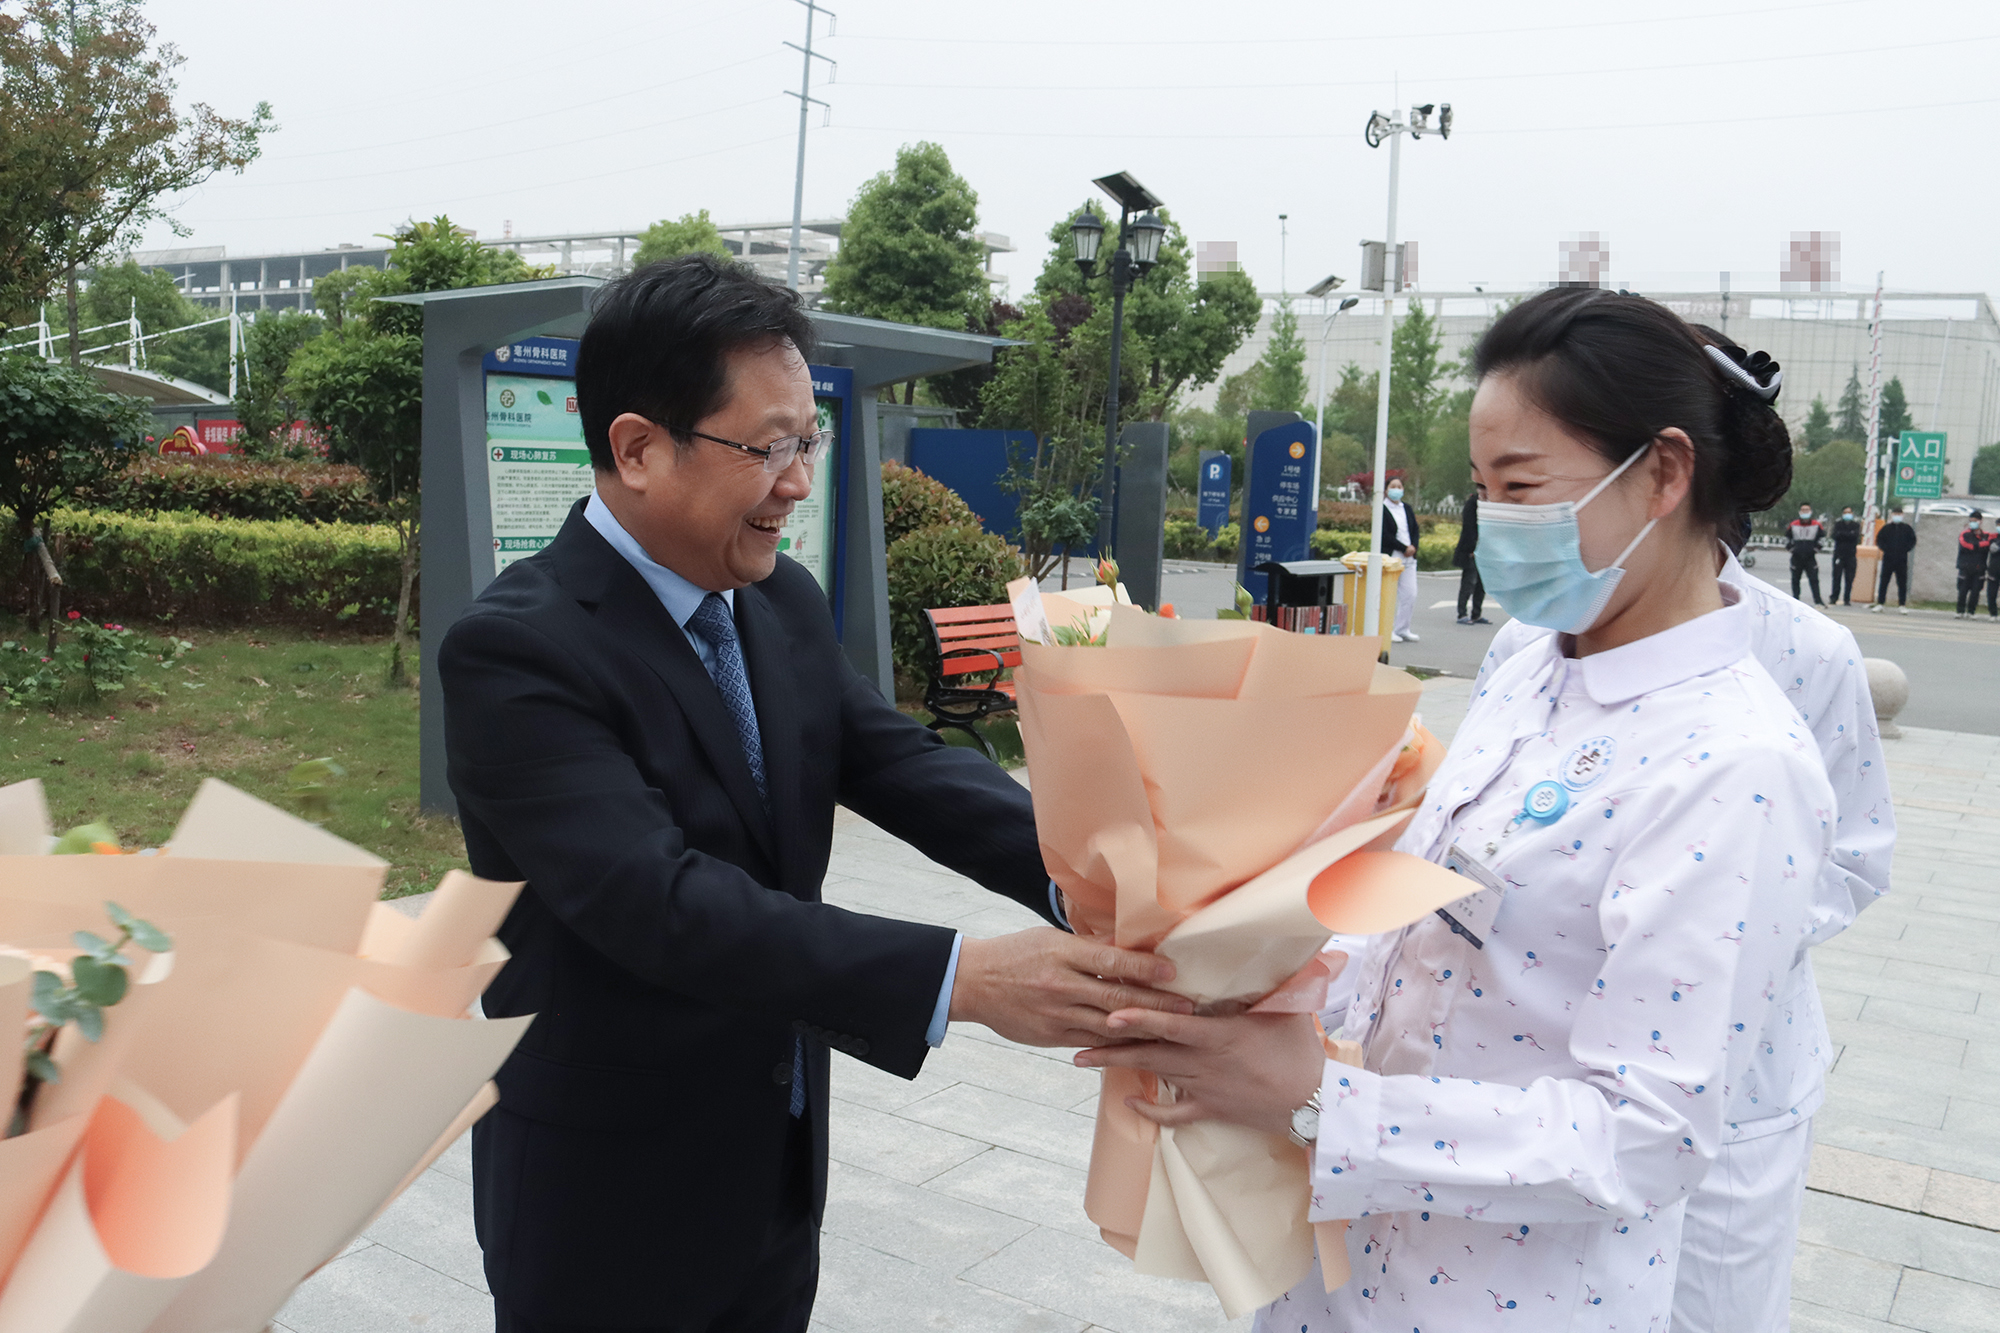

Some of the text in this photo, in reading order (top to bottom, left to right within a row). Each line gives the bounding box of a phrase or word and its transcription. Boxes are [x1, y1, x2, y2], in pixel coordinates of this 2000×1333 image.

[1903, 437, 1940, 458] 入口
[510, 450, 557, 461] 现场心肺复苏
[1209, 463, 1221, 479] P
[1284, 465, 1301, 473] 1号楼
[1280, 481, 1300, 490] 停车场
[1254, 552, 1272, 561] 2号楼
